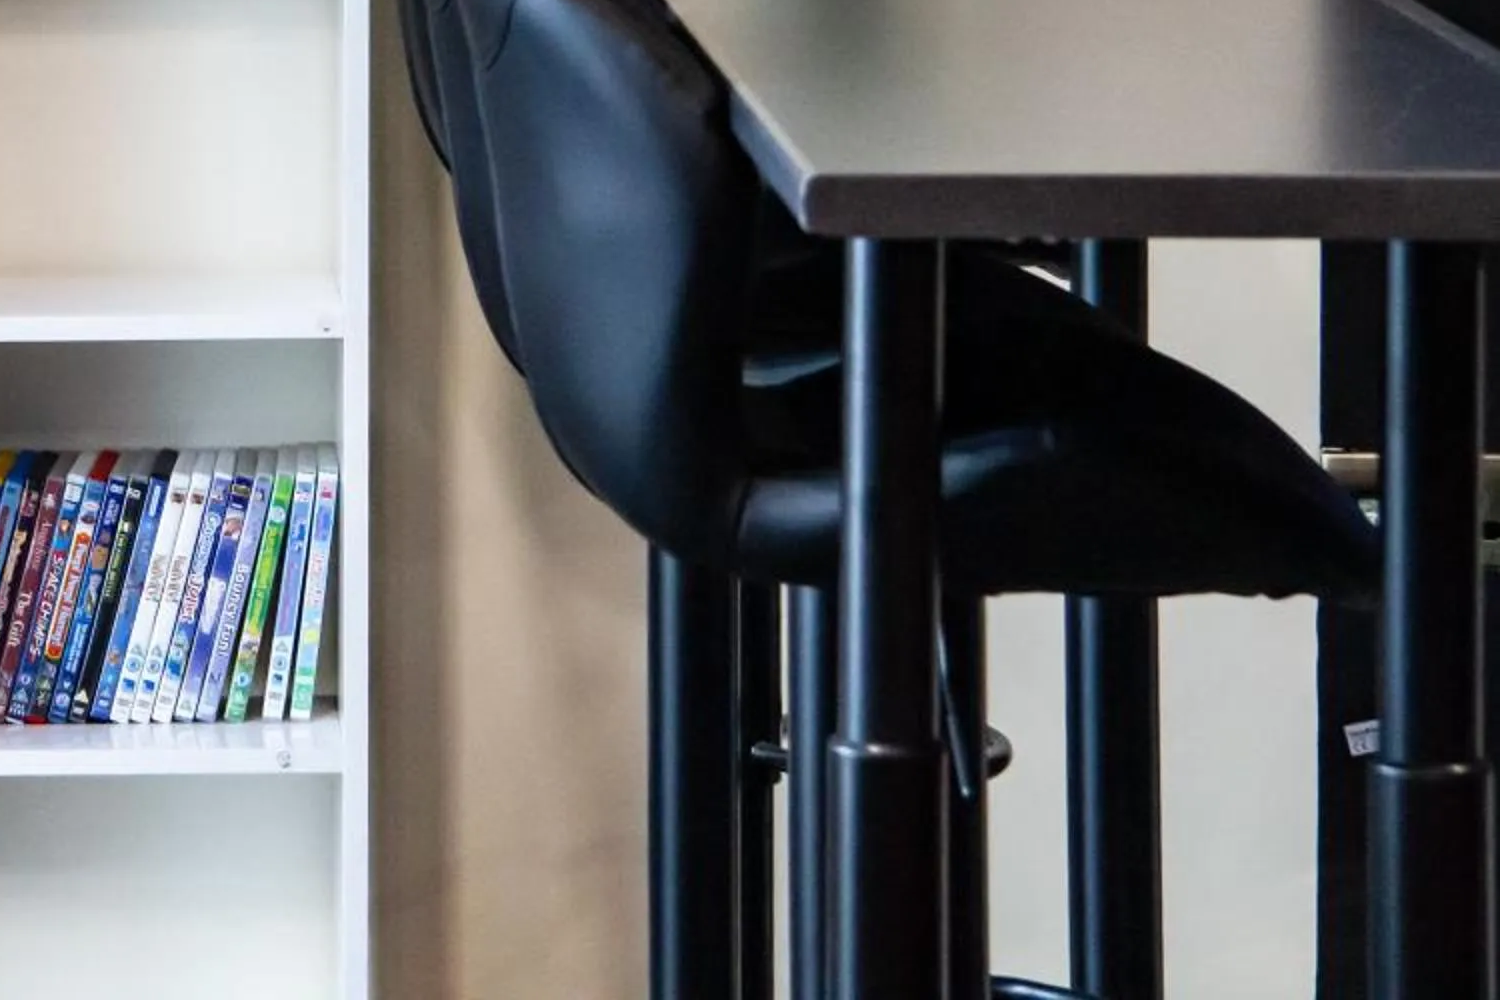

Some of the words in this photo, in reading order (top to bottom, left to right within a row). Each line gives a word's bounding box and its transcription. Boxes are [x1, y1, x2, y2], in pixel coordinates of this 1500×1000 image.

[45, 554, 65, 602] SPACE
[16, 591, 31, 616] The
[7, 618, 25, 648] Gift
[29, 600, 53, 656] CHIMPS
